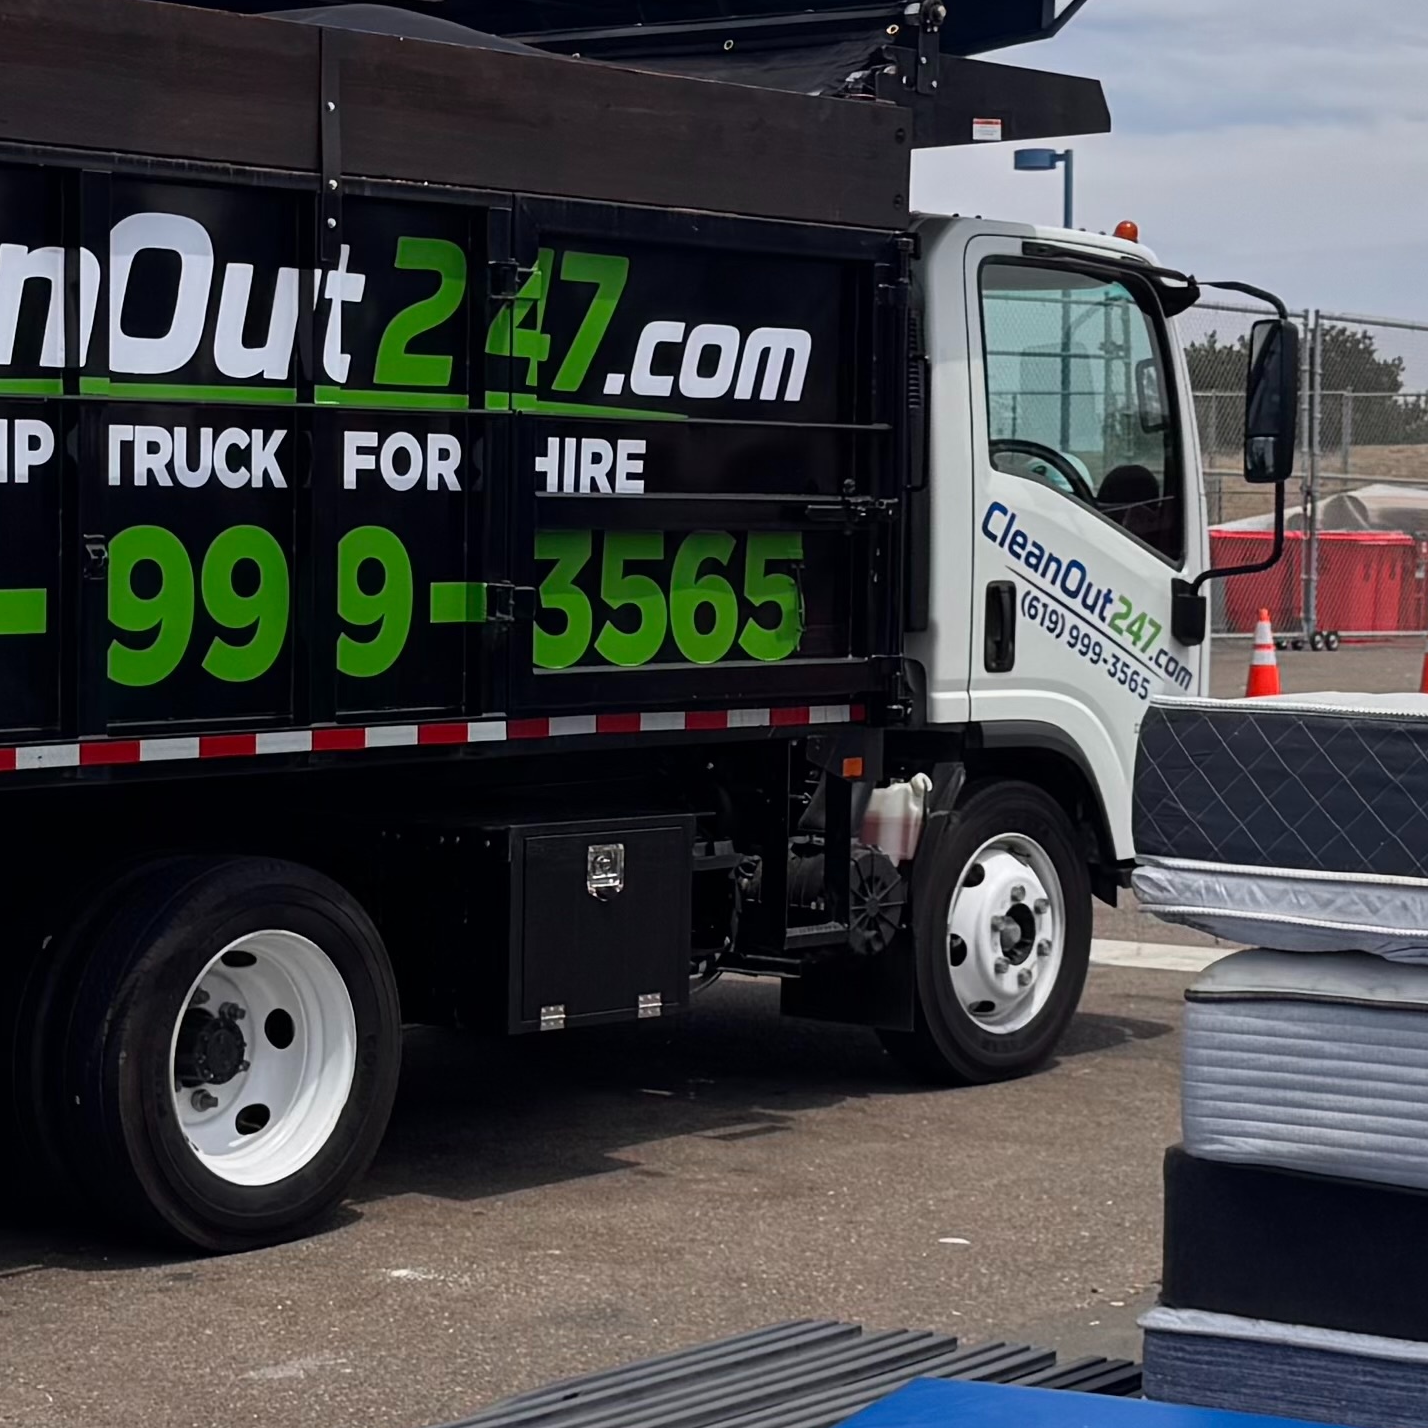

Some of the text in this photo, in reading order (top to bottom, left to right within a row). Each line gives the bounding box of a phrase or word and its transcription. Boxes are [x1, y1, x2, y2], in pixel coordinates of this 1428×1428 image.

[108, 423, 289, 490] TRUCK
[343, 430, 462, 492] FOR
[534, 436, 647, 494] HIRE
[981, 500, 1194, 691] CleanOut247.com
[1020, 589, 1151, 701] (619) 999-3565
